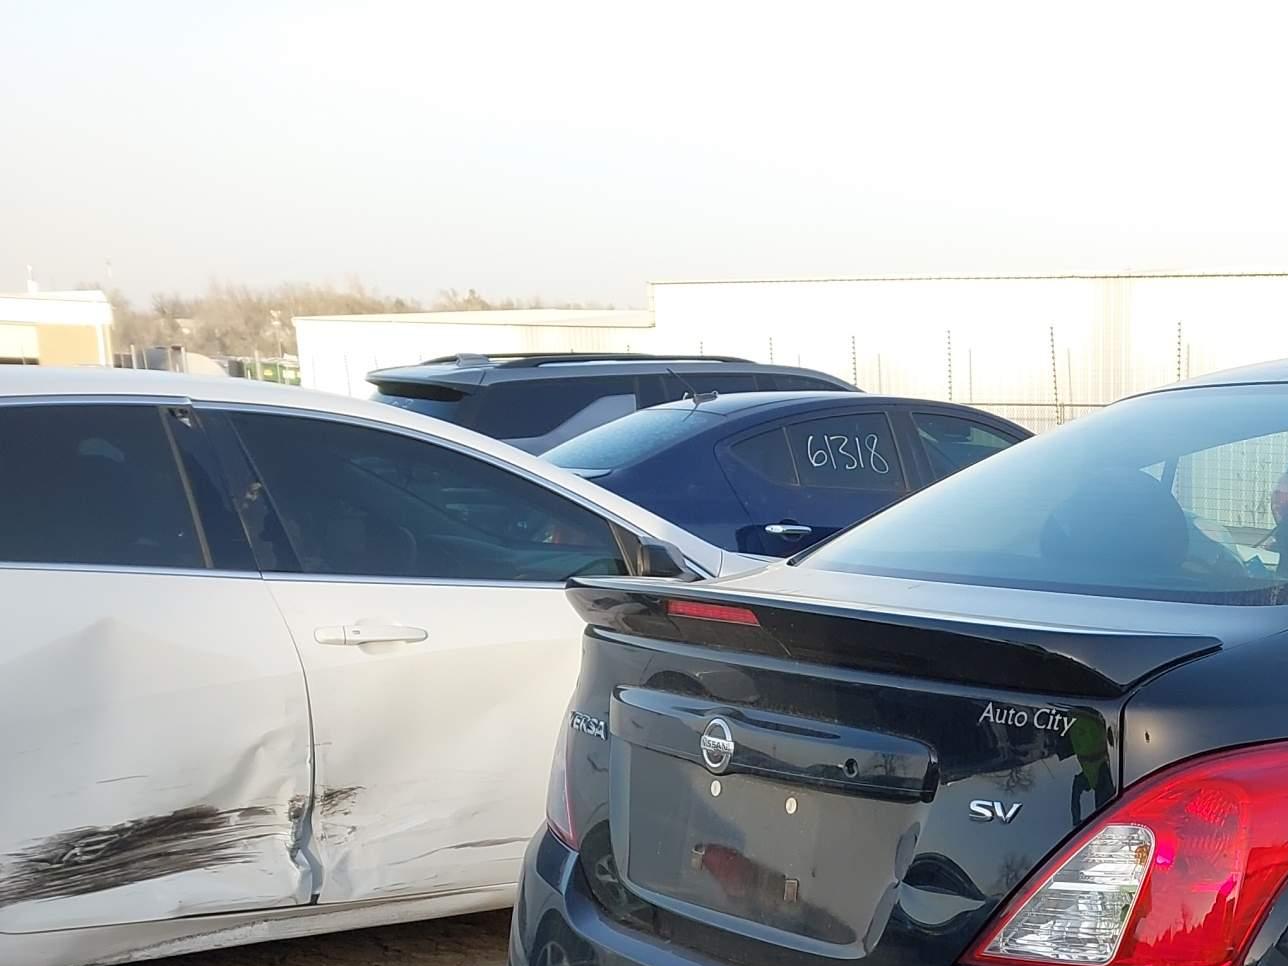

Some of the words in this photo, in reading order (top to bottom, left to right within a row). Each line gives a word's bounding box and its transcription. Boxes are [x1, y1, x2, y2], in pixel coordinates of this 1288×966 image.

[807, 434, 889, 474] 61318
[977, 702, 1028, 727] Auto
[1033, 707, 1077, 736] City
[969, 799, 1022, 824] SV
